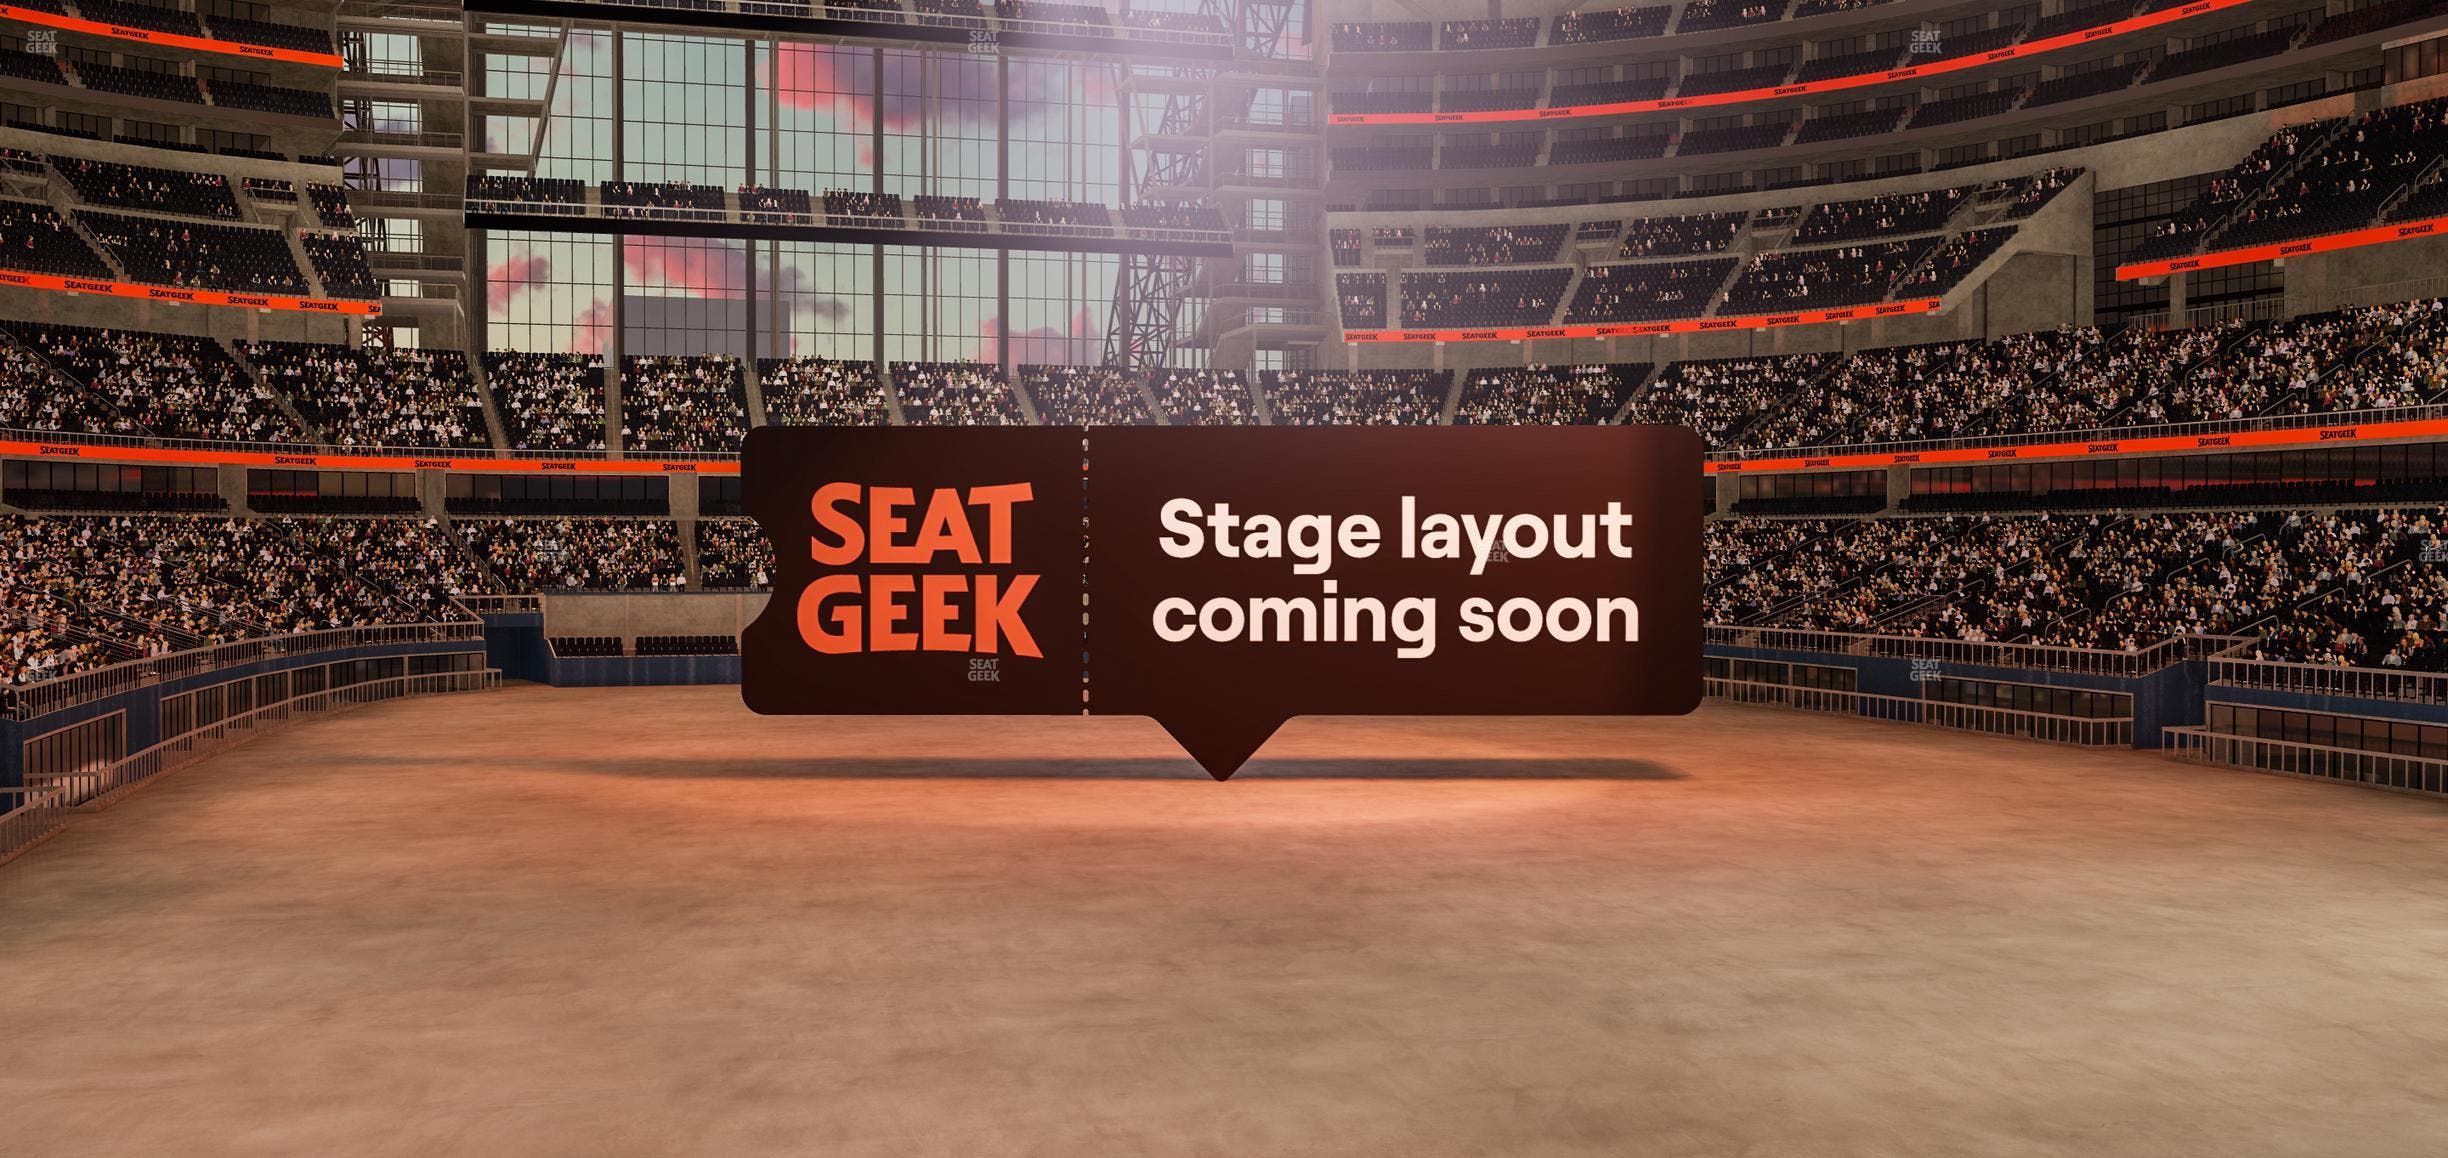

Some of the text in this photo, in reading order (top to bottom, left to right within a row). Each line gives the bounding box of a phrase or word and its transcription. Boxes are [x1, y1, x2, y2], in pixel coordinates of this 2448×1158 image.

[2182, 2, 2210, 15] SEATGEEK
[112, 27, 148, 39] SEATGEEK
[2085, 27, 2112, 39] SEATGEEK
[240, 46, 273, 56] SEATGEEK
[1988, 49, 2014, 60] SEATGEEK
[1888, 69, 1917, 79] SEATGEEK
[1775, 86, 1806, 95] SEATGEEK
[2399, 223, 2434, 237] SEATGEEK
[2280, 242, 2312, 255] SEATGEEK
[2169, 260, 2200, 271] SEATGEEK
[64, 280, 112, 293] SEATGEEK
[149, 289, 194, 300] SEATGEEK
[228, 296, 269, 306] SEATGEEK
[300, 301, 338, 311] SEATGEEK
[1876, 305, 1904, 314] SEATGEEK
[1825, 310, 1853, 320] SEATGEEK
[1700, 320, 1736, 329] SEATGEEK
[1767, 316, 1799, 325] SEATGEEK
[1527, 330, 1566, 338] SEATGEEK
[2320, 428, 2356, 440] SEATGEEK
[2198, 436, 2230, 446] SEATGEEK
[40, 446, 80, 456] SEATGEEK
[2088, 443, 2118, 453] SEATGEEK
[1894, 454, 1920, 463] SEATGEEK
[1988, 449, 2016, 458] SEATGEEK
[275, 456, 317, 465] SEATGEEK
[415, 460, 451, 468] SEATGEEK
[1805, 459, 1830, 467] SEATGEEK
[1718, 463, 1741, 471] SEATGEEK
[812, 482, 1033, 565] SEAT
[1159, 496, 1632, 575] Stage layout
[797, 575, 1043, 658] GEEK
[1153, 580, 1638, 658] coming soon
